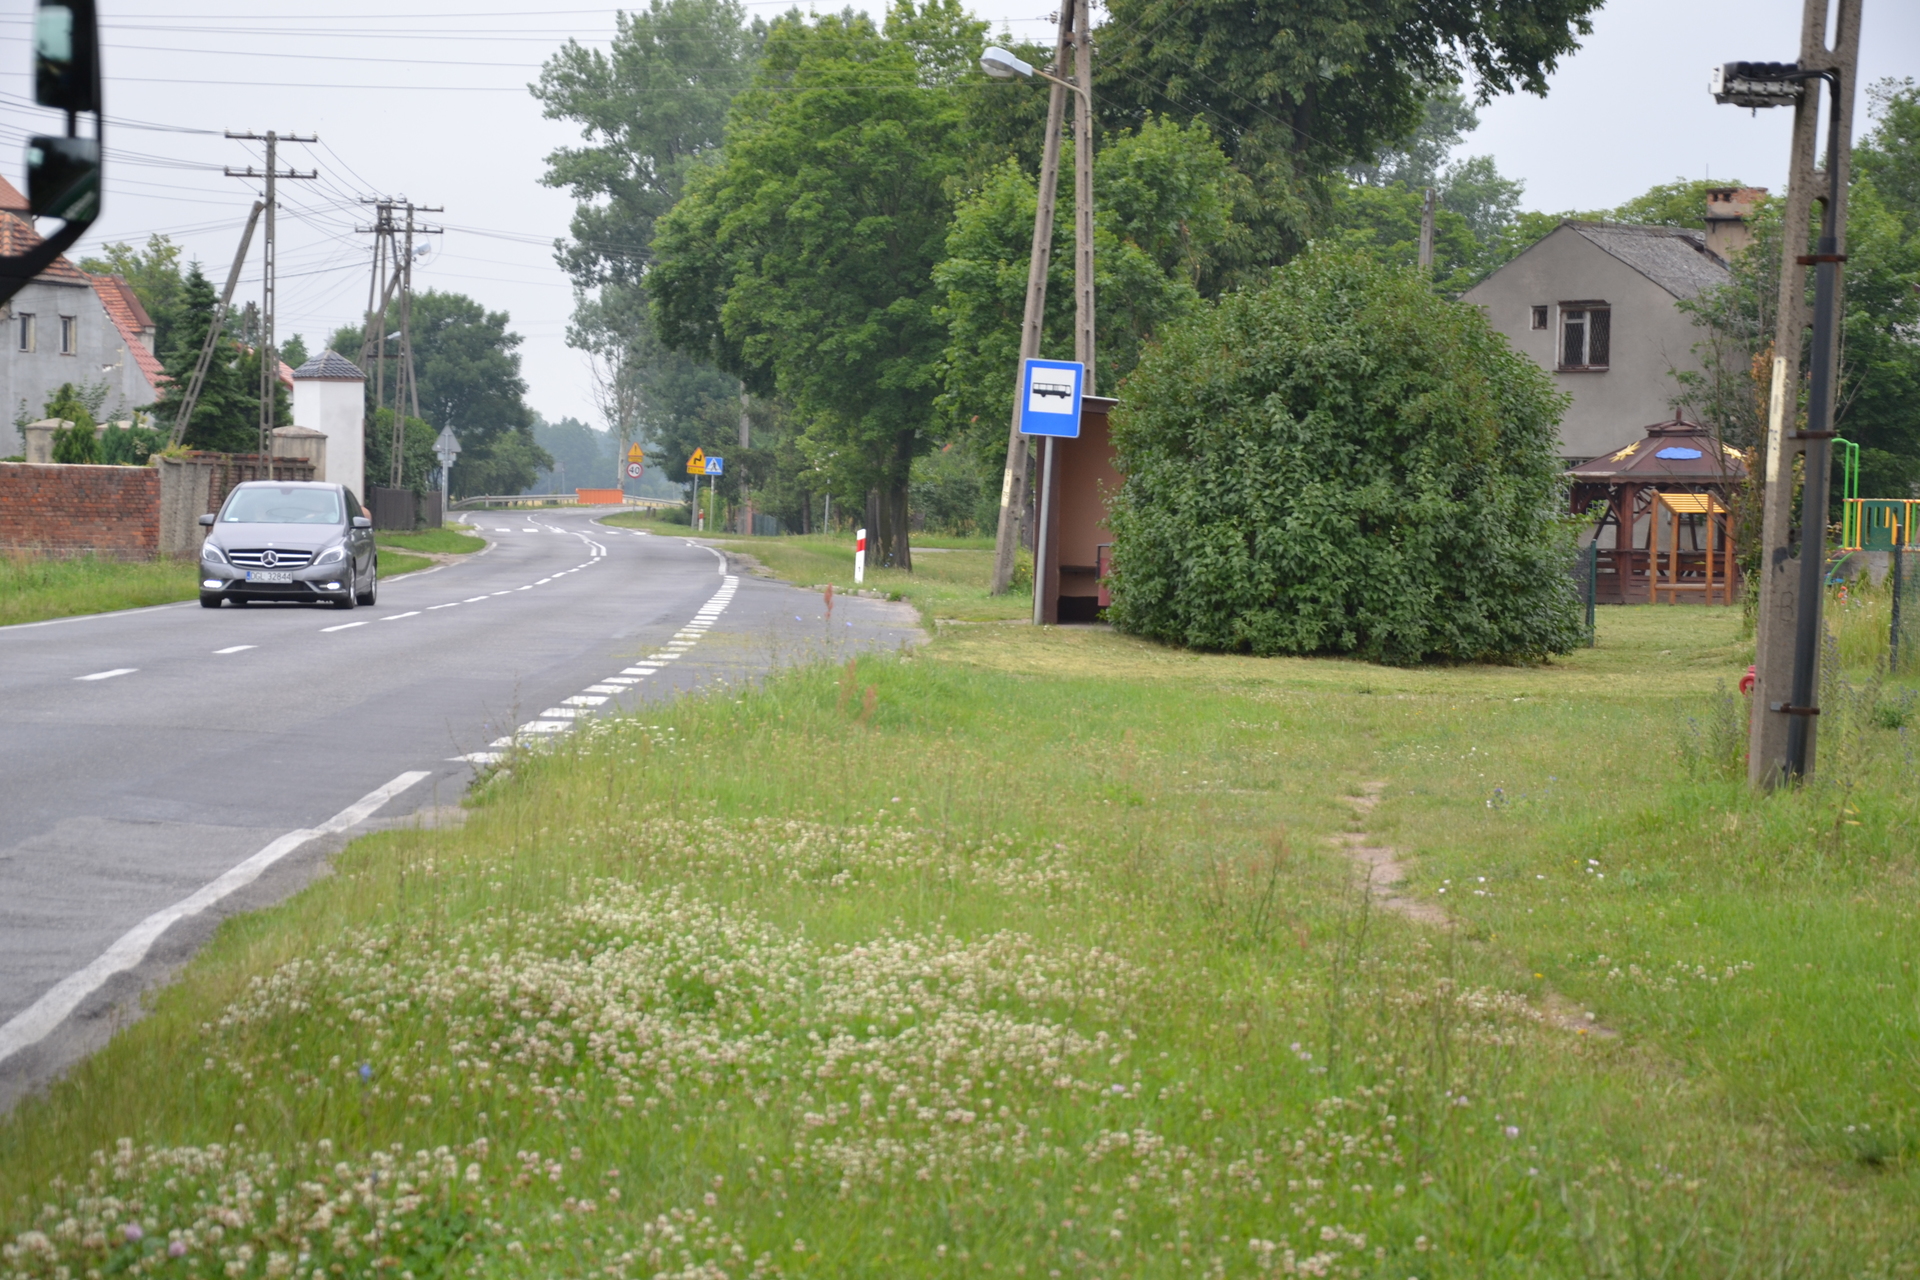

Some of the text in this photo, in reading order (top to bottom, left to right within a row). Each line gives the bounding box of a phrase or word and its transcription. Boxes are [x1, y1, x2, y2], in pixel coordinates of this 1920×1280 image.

[629, 466, 640, 475] 40
[251, 571, 291, 581] DGL 32844
